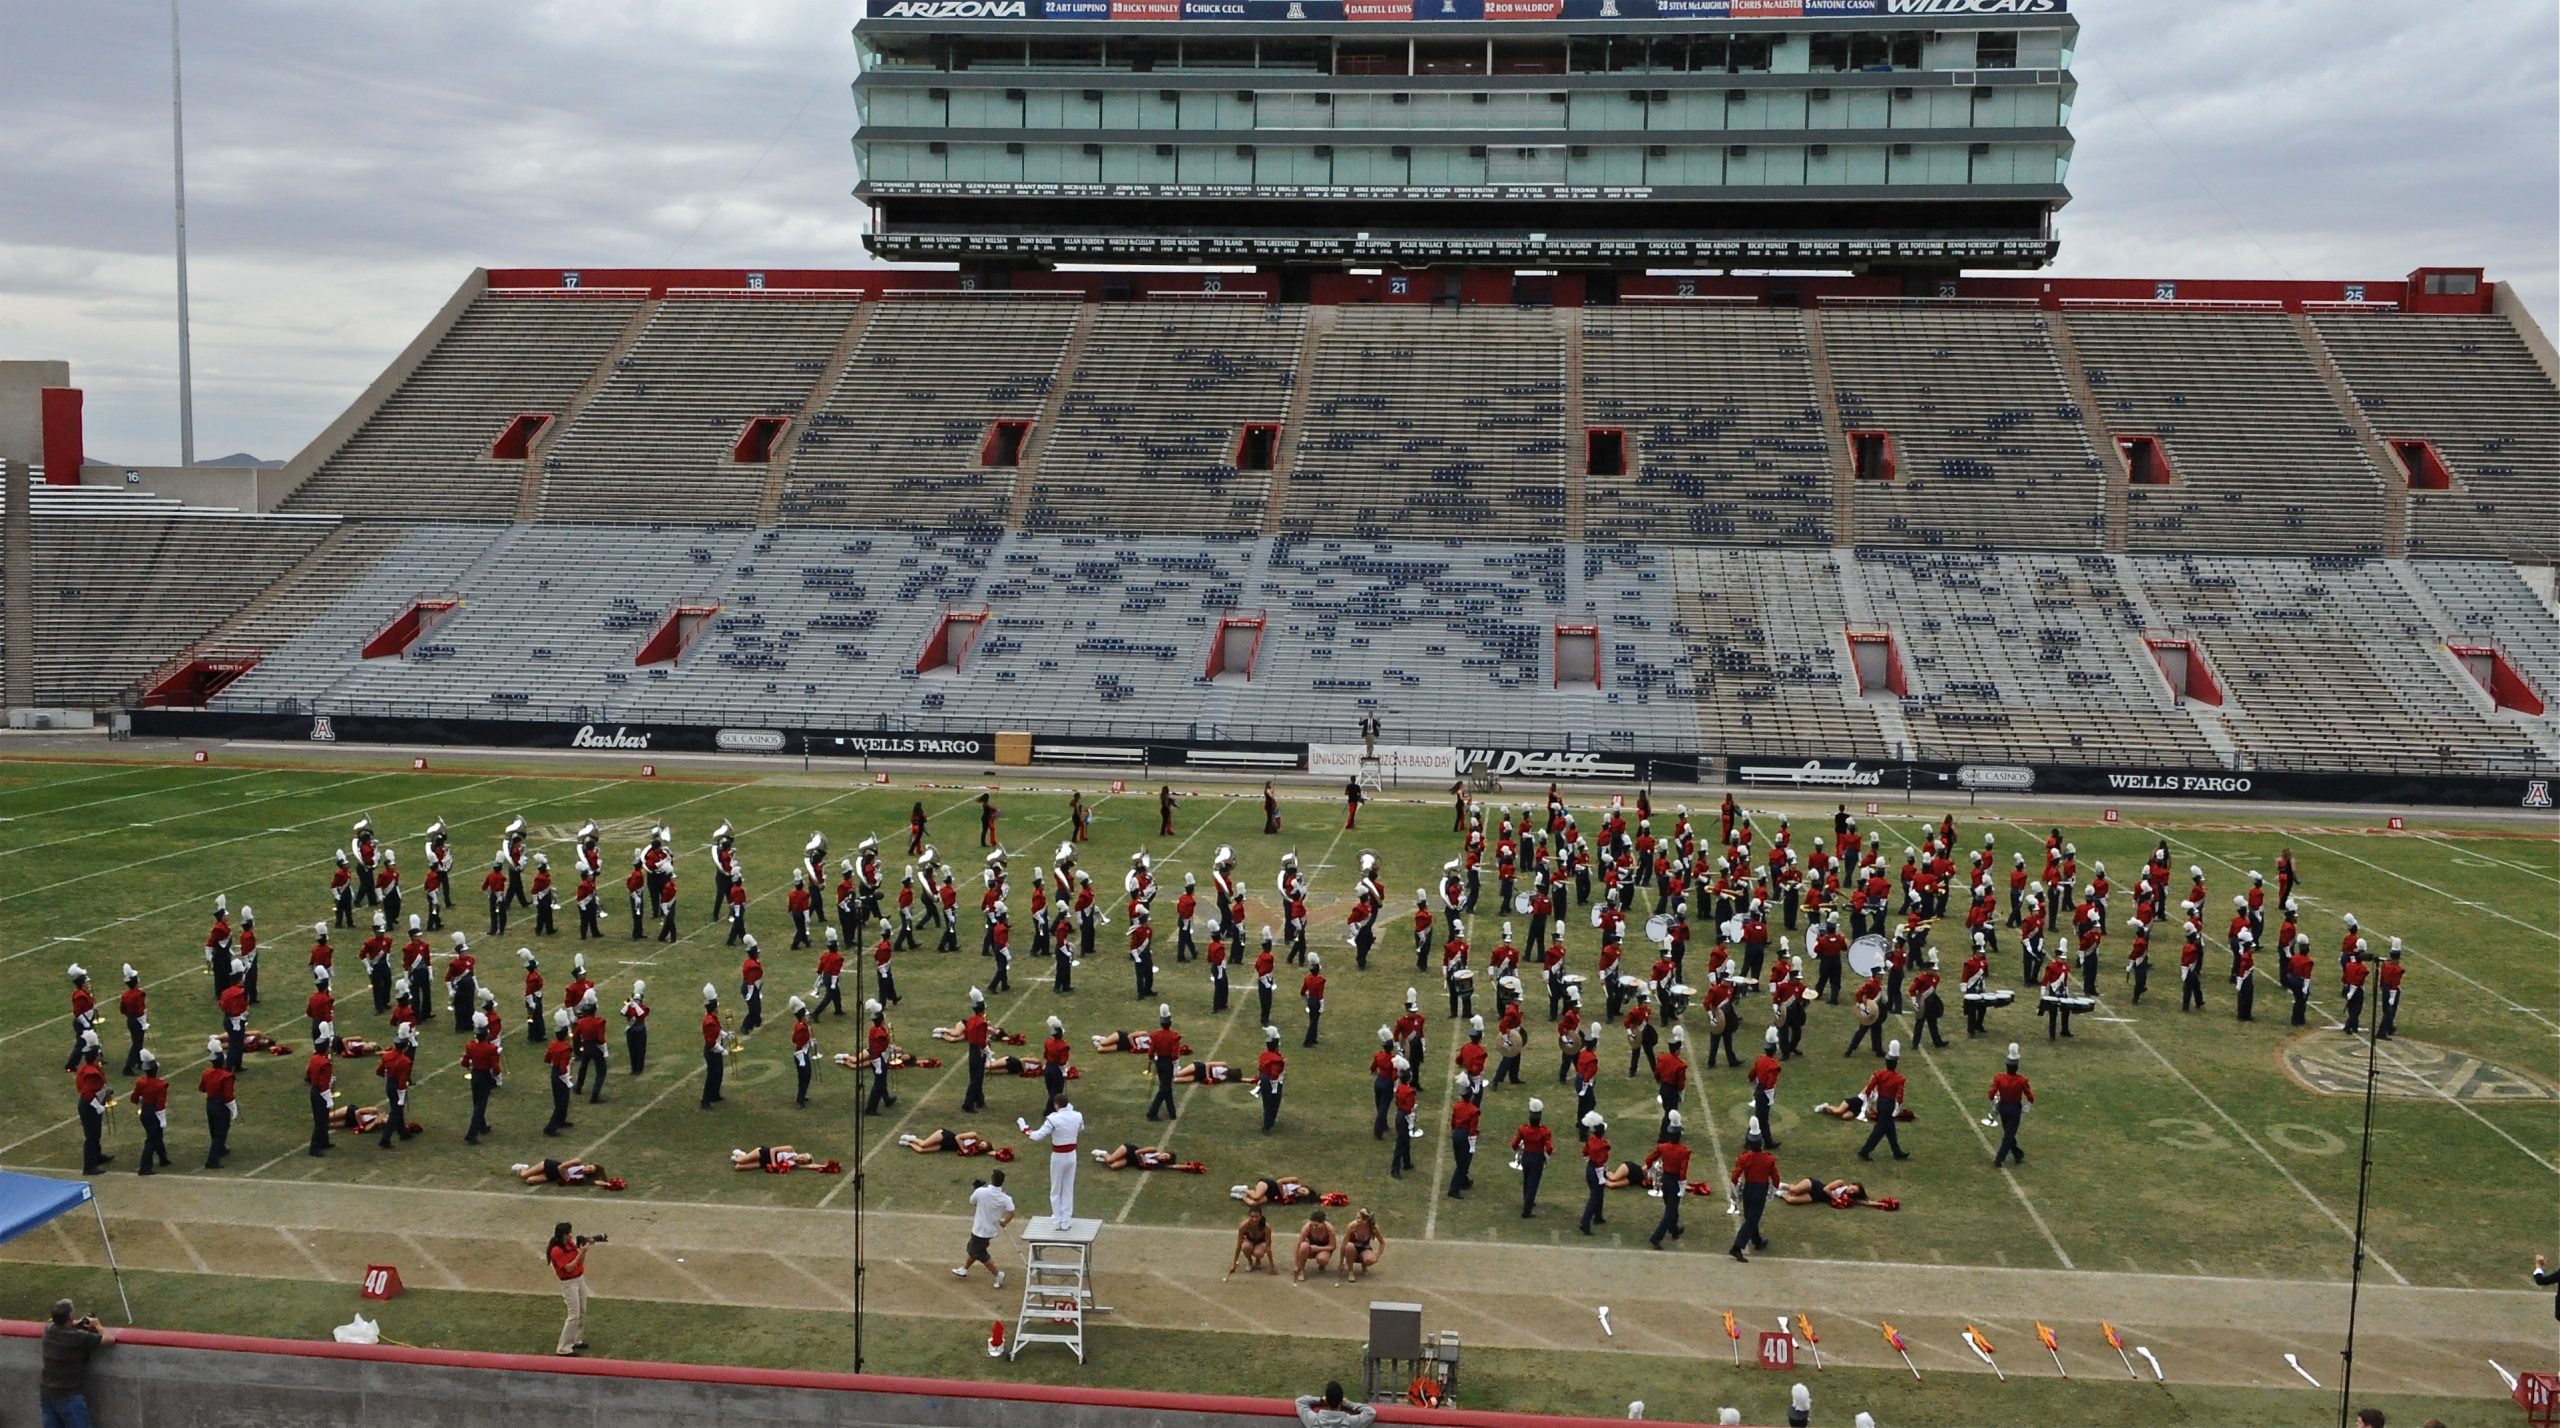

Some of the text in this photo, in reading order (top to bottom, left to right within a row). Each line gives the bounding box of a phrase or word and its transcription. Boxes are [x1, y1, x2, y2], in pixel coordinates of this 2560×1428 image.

[883, 2, 1026, 17] ARIZONA
[1046, 3, 1106, 12] 22 ART LUPPINO
[1123, 4, 1148, 12] RICKY
[1149, 4, 1179, 12] HUNLEY
[1192, 4, 1221, 13] CHUCK
[1222, 4, 1244, 14] CECIL
[1344, 4, 1412, 14] 4 DARRYLL LEWIS
[1485, 3, 1554, 12] 92 ROB WALDROP
[1669, 2, 1688, 10] STEVE
[1739, 1, 1762, 9] CHRIS
[1805, 0, 1875, 8] 5 ANTOINE CASON
[565, 278, 577, 288] 17
[749, 278, 762, 290] 18
[962, 280, 975, 290] 19
[1205, 281, 1220, 292] 20
[1392, 282, 1406, 293] 21
[1679, 284, 1694, 296] 22
[1940, 286, 1955, 298] 23
[2157, 289, 2173, 301] 24
[2346, 291, 2363, 302] 25
[127, 472, 138, 482] 16
[572, 725, 651, 748] Bashas'
[741, 735, 778, 744] CASINOS
[851, 738, 979, 753] WELLS FARGO
[1313, 753, 1357, 765] UNIVERSITY
[1410, 755, 1432, 767] BAND
[1434, 756, 1452, 768] DAY
[1985, 772, 2027, 781] CASINOS
[2108, 775, 2251, 792] WELLS FARGO
[365, 1270, 388, 1294] 40
[1055, 1302, 1073, 1322] 50
[1764, 1338, 1788, 1364] 40
